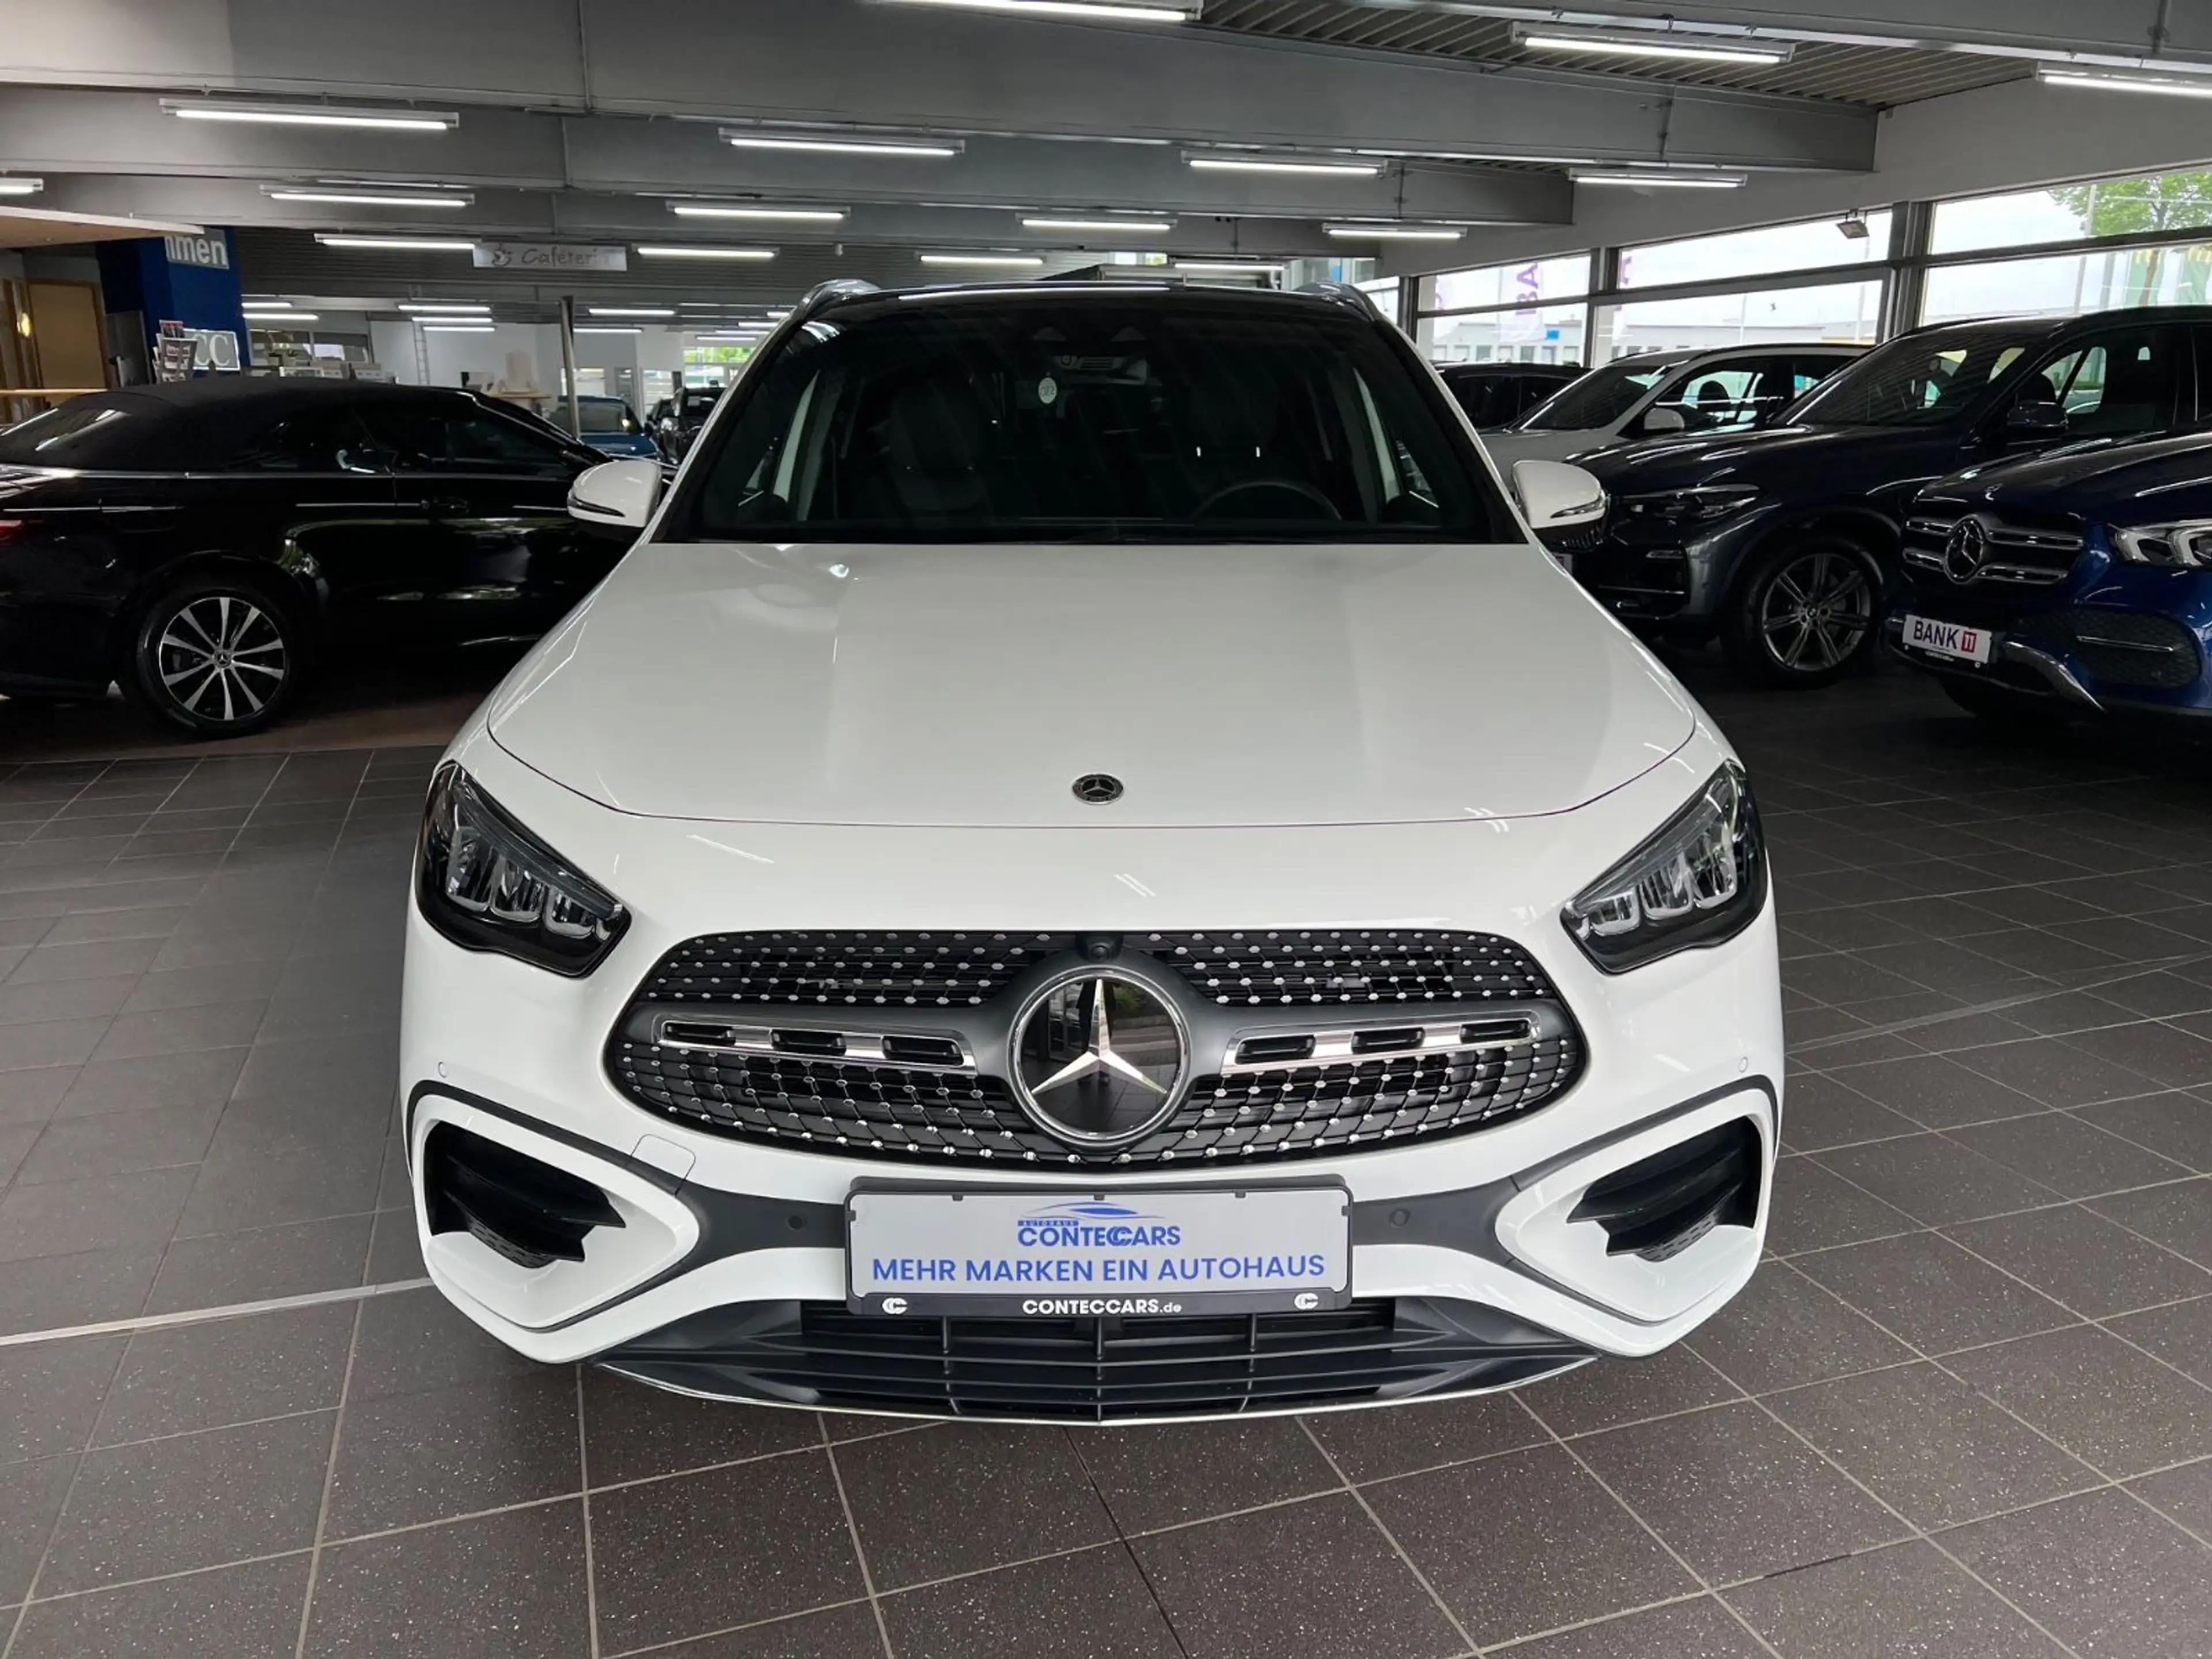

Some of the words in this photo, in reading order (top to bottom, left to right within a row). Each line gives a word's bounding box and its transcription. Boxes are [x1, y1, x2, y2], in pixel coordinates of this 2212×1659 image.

[1913, 620, 1960, 650] BANK
[1017, 1225, 1181, 1247] CONTECCARS
[872, 1258, 956, 1281] MEHR
[965, 1259, 1093, 1282] MARKEN
[1103, 1259, 1148, 1282] EIN
[1157, 1254, 1325, 1281] AUTOHAUS
[1022, 1298, 1182, 1315] CONTECCARS.de
